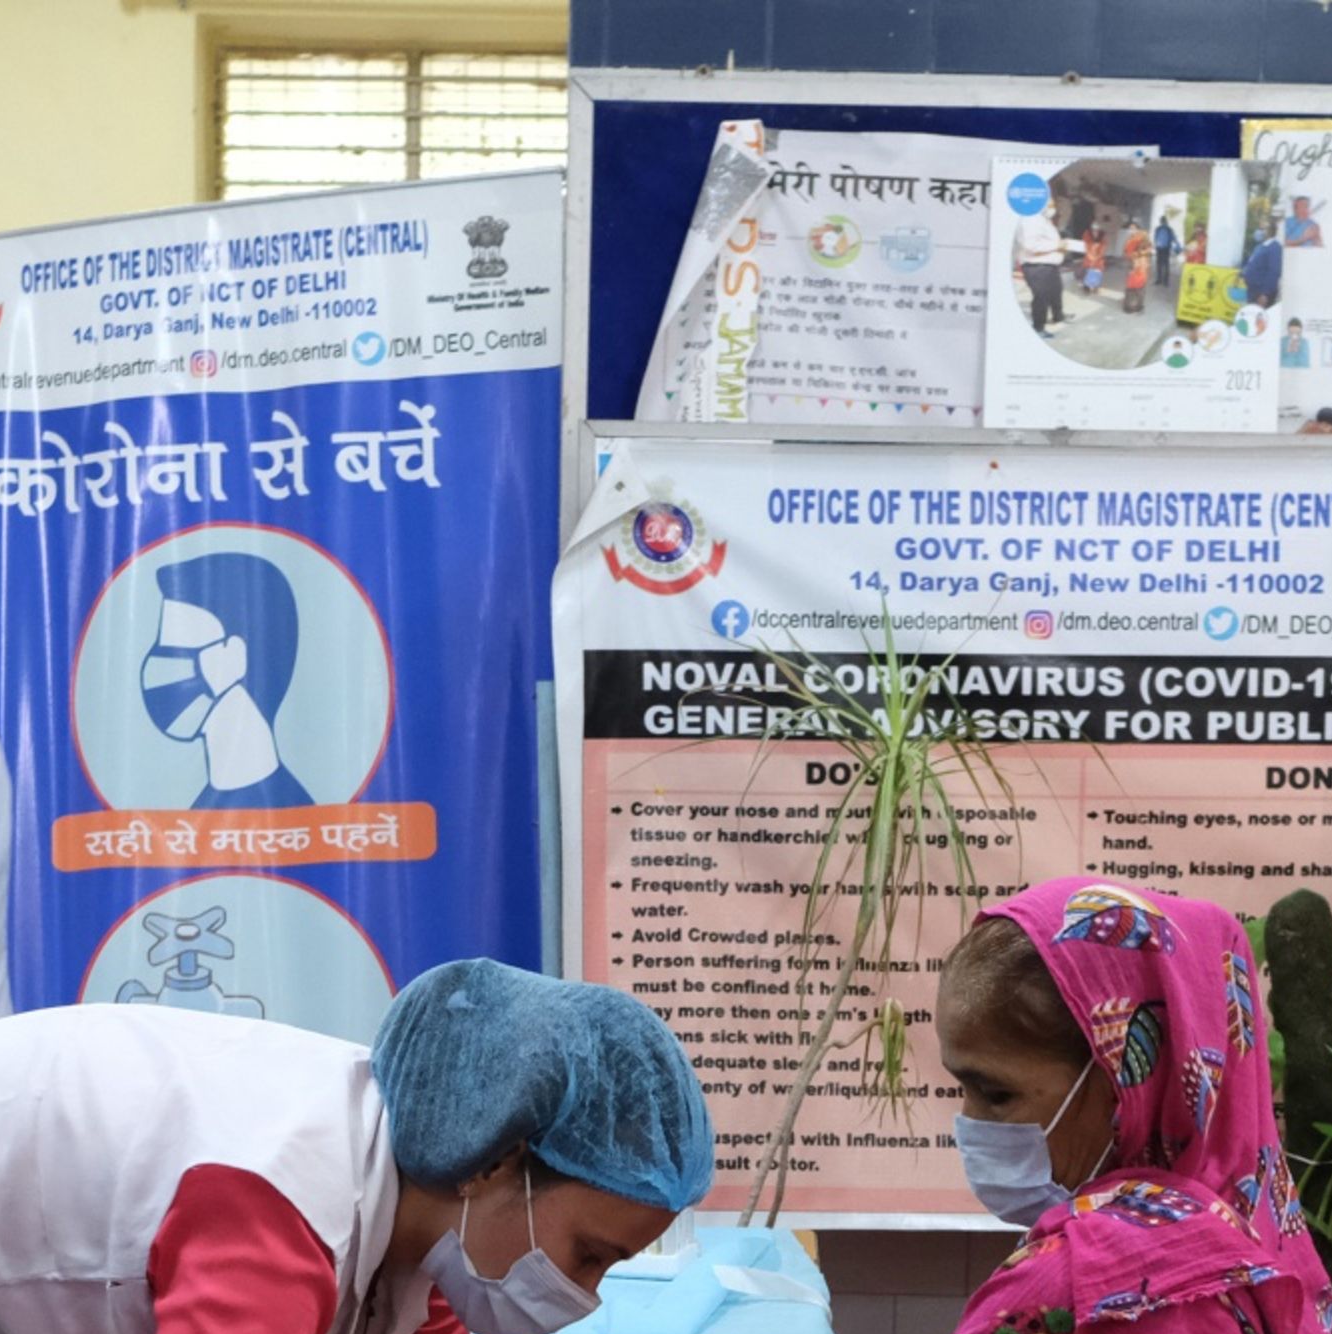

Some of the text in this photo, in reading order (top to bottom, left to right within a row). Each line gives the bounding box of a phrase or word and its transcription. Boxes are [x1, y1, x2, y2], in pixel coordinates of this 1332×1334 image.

[767, 161, 821, 203] मेरी
[830, 165, 919, 202] पोषण
[929, 177, 990, 208] कहा
[21, 257, 79, 293] OFFICE
[83, 254, 104, 287] OF
[109, 249, 141, 281] THE
[228, 228, 334, 270] MAGISTRATE
[339, 219, 429, 266] (CENTRAL)
[100, 288, 159, 314] GOVT.
[168, 285, 194, 307] OF
[252, 278, 278, 300] OF
[285, 270, 347, 295] DELHI
[103, 321, 153, 341] Darya
[211, 312, 252, 330] New
[258, 306, 299, 327] Delhi
[305, 298, 377, 320] -110002
[388, 328, 548, 360] /DM_DEO_Central
[1225, 370, 1262, 390] 2021
[253, 411, 311, 498] से
[332, 400, 443, 492] बचें
[768, 488, 859, 525] OFFICE
[868, 489, 902, 525] OF
[911, 490, 960, 525] THE
[969, 491, 1089, 527] DISTRICT
[1097, 491, 1261, 527] MAGISTRATE
[895, 536, 1280, 563] GOVT. OF NCT OF DELHI
[850, 571, 1324, 597] 14, Darya Ganj, New Delhi -110002
[1057, 611, 1199, 633] /dm.deo.central
[642, 661, 789, 693] NOVAL
[803, 664, 1125, 697] CORONAVIRUS
[643, 705, 852, 736] GENERAL
[1105, 711, 1193, 740] FOR
[630, 803, 684, 817] Cover
[689, 804, 730, 820] your
[735, 806, 779, 818] nose
[785, 805, 819, 818] and
[1104, 810, 1187, 829] Touching
[1193, 812, 1242, 829] eyes,
[1248, 813, 1292, 827] nose
[1297, 814, 1317, 827] or
[85, 819, 153, 858] सही
[164, 819, 198, 858] से
[320, 812, 400, 852] पहनें
[630, 828, 687, 842] tissue
[693, 830, 713, 842] or
[994, 835, 1014, 846] or
[1102, 836, 1154, 851] hand.
[630, 853, 719, 870] sneezing.
[1103, 862, 1184, 880] Hugging,
[1189, 862, 1255, 880] kissing
[1261, 863, 1295, 878] and
[631, 878, 730, 896] Frequently
[735, 881, 784, 894] wash
[631, 904, 688, 917] water.
[631, 929, 681, 943] Avoid
[688, 928, 768, 944] Crowded
[632, 955, 694, 968] Person
[701, 954, 781, 973] suffering
[632, 980, 677, 993] must
[683, 980, 705, 993] be
[711, 979, 789, 994] confined
[678, 1005, 867, 1021] more then one am's
[710, 1030, 793, 1045] sick with
[692, 1056, 860, 1072] dequate and
[748, 1080, 767, 1095] of
[935, 1086, 964, 1099] eat
[801, 1134, 930, 1149] with Influenza
